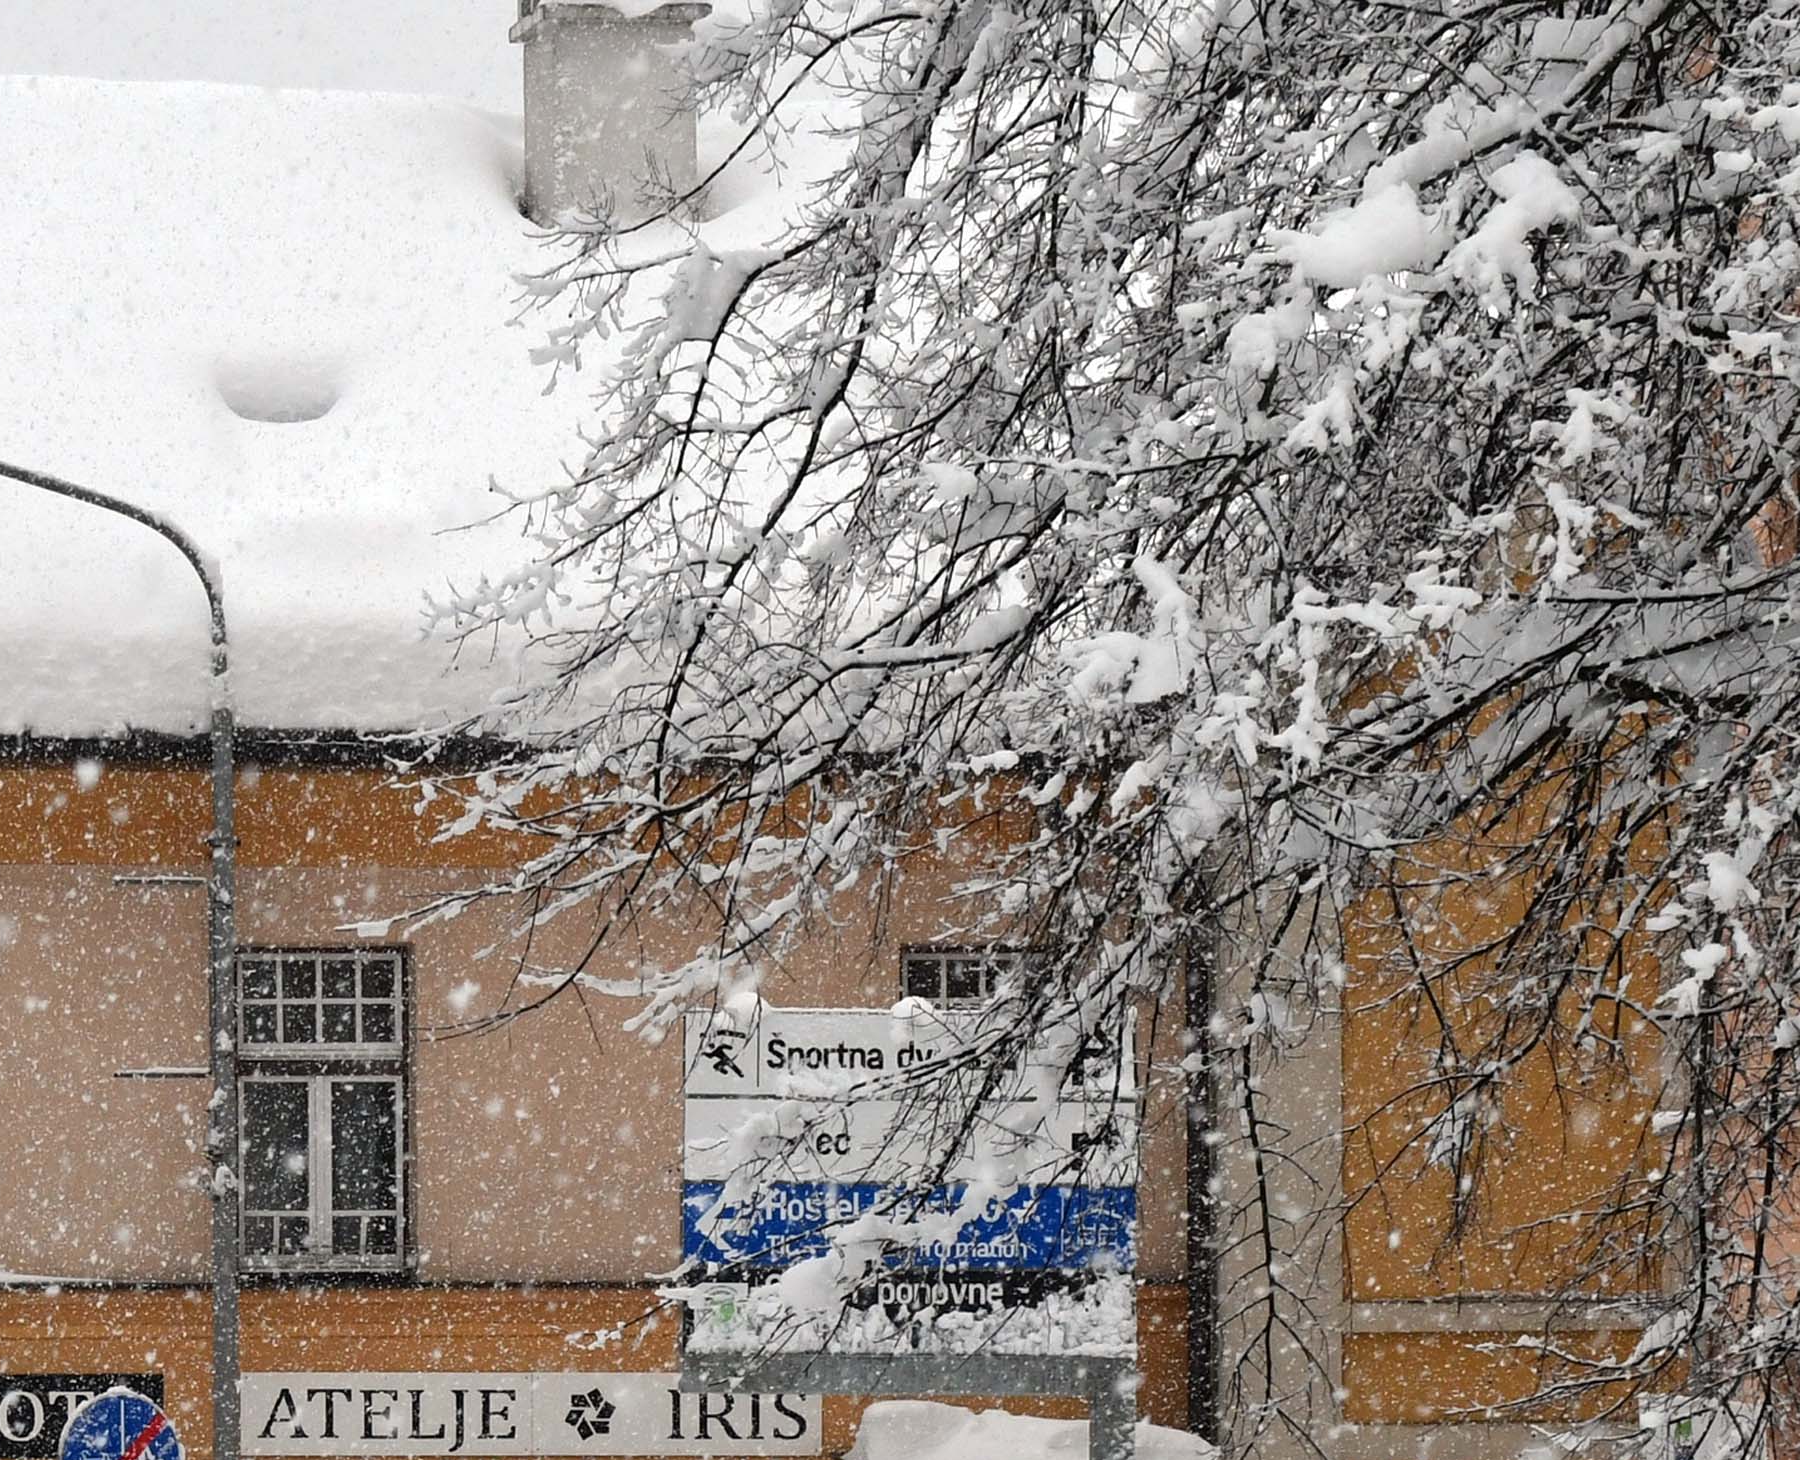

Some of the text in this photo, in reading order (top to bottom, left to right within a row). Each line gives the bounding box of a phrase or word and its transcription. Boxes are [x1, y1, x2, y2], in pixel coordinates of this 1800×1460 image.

[766, 1031, 884, 1076] Športna
[877, 1281, 1005, 1310] ponovne
[257, 1387, 517, 1452] ATELJE
[666, 1389, 808, 1440] IRIS
